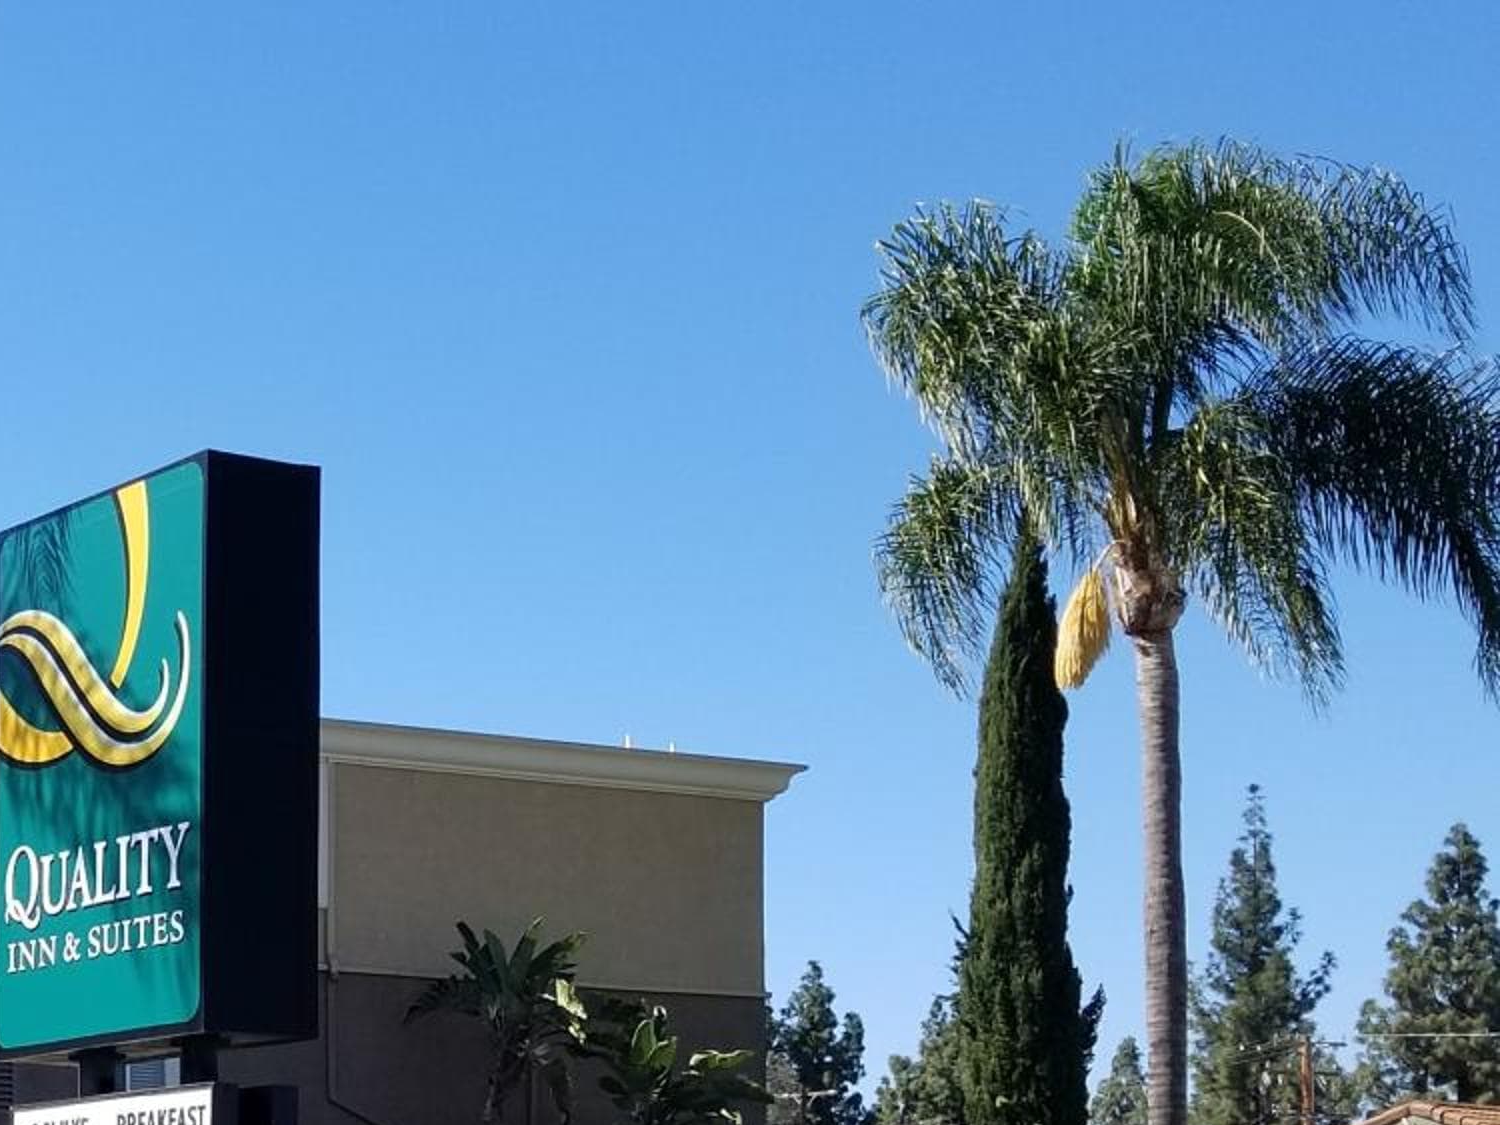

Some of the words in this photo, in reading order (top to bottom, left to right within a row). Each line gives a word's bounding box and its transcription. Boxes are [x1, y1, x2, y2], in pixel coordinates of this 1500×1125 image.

[5, 822, 190, 929] QUALITY
[7, 936, 56, 973] INN
[63, 932, 81, 962] &
[88, 910, 184, 958] SUITES
